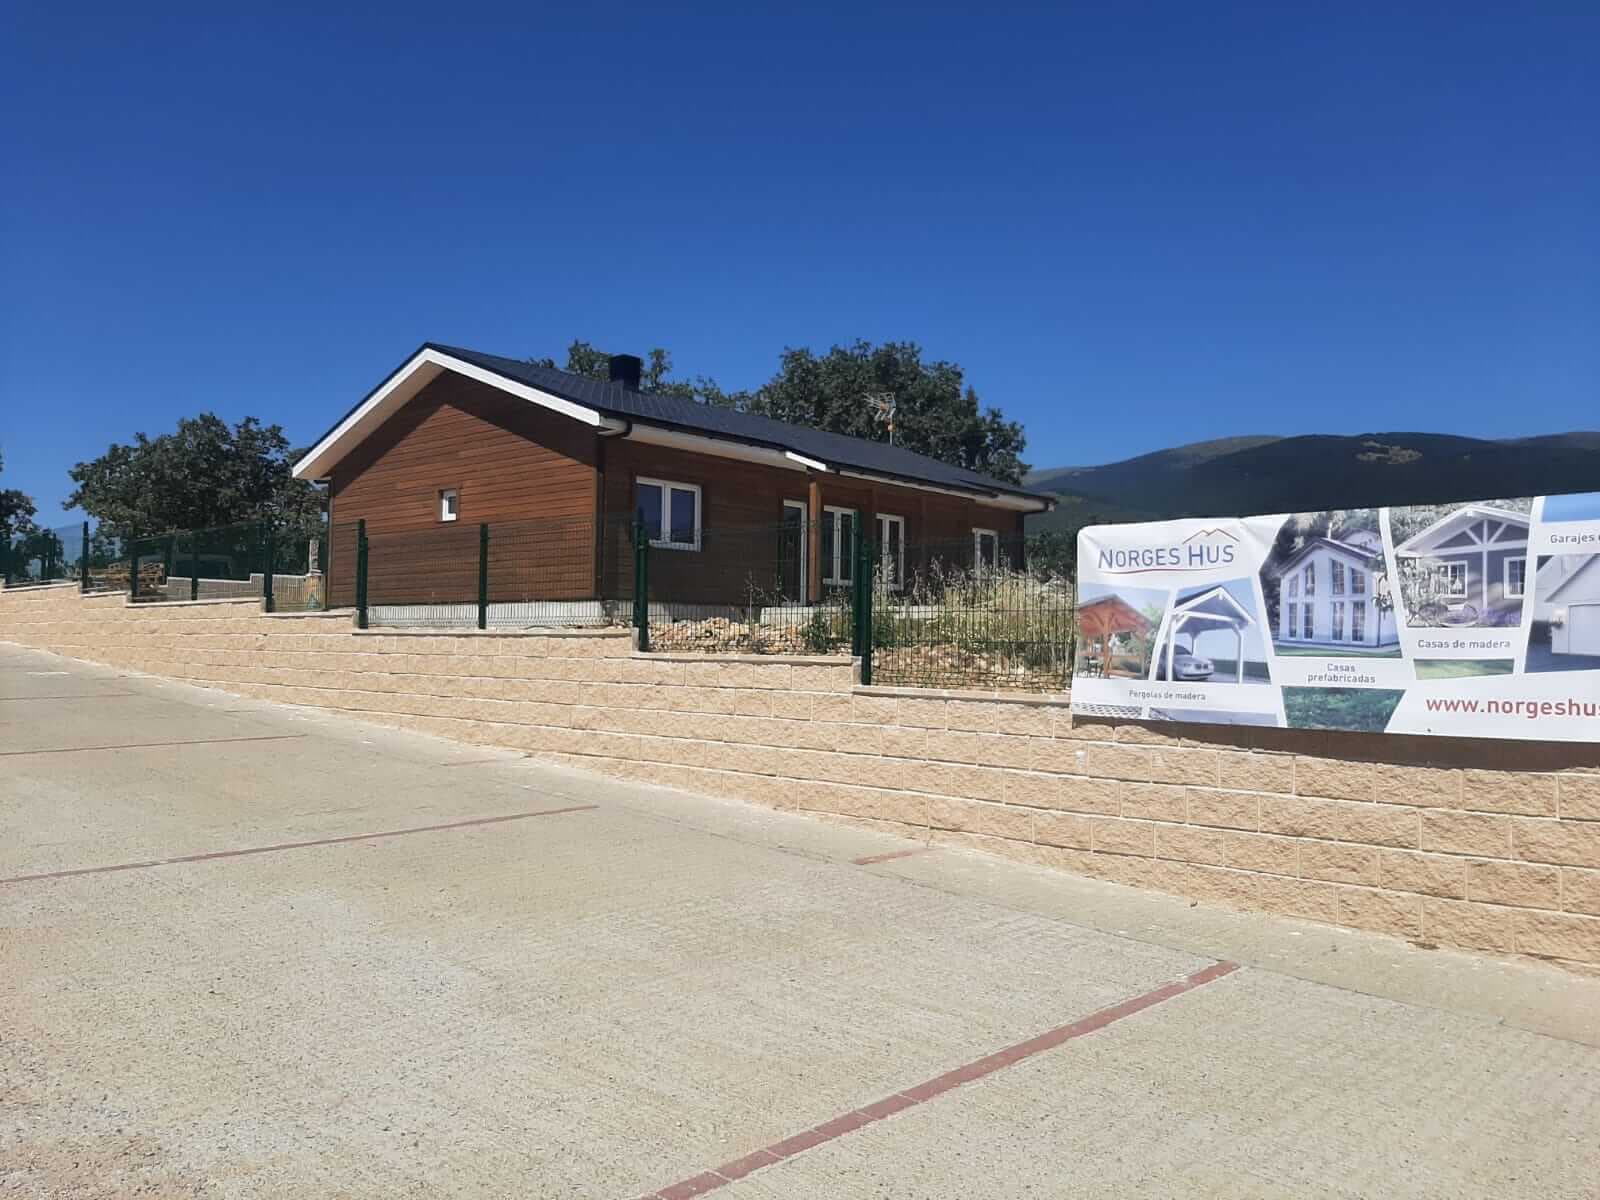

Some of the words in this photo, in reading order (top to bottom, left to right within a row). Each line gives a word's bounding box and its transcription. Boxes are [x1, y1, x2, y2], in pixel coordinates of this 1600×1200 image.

[1550, 531, 1595, 545] Garajes
[1098, 548, 1180, 569] NORGES
[1188, 544, 1234, 566] HUS
[1417, 639, 1450, 649] Casas
[1452, 639, 1466, 649] de
[1469, 639, 1511, 649] madera
[1327, 663, 1356, 672] Casas
[1307, 673, 1376, 684] prefabricadas
[1163, 691, 1173, 700] de
[1175, 692, 1207, 701] madera
[1426, 698, 1600, 719] www.norgeshu
